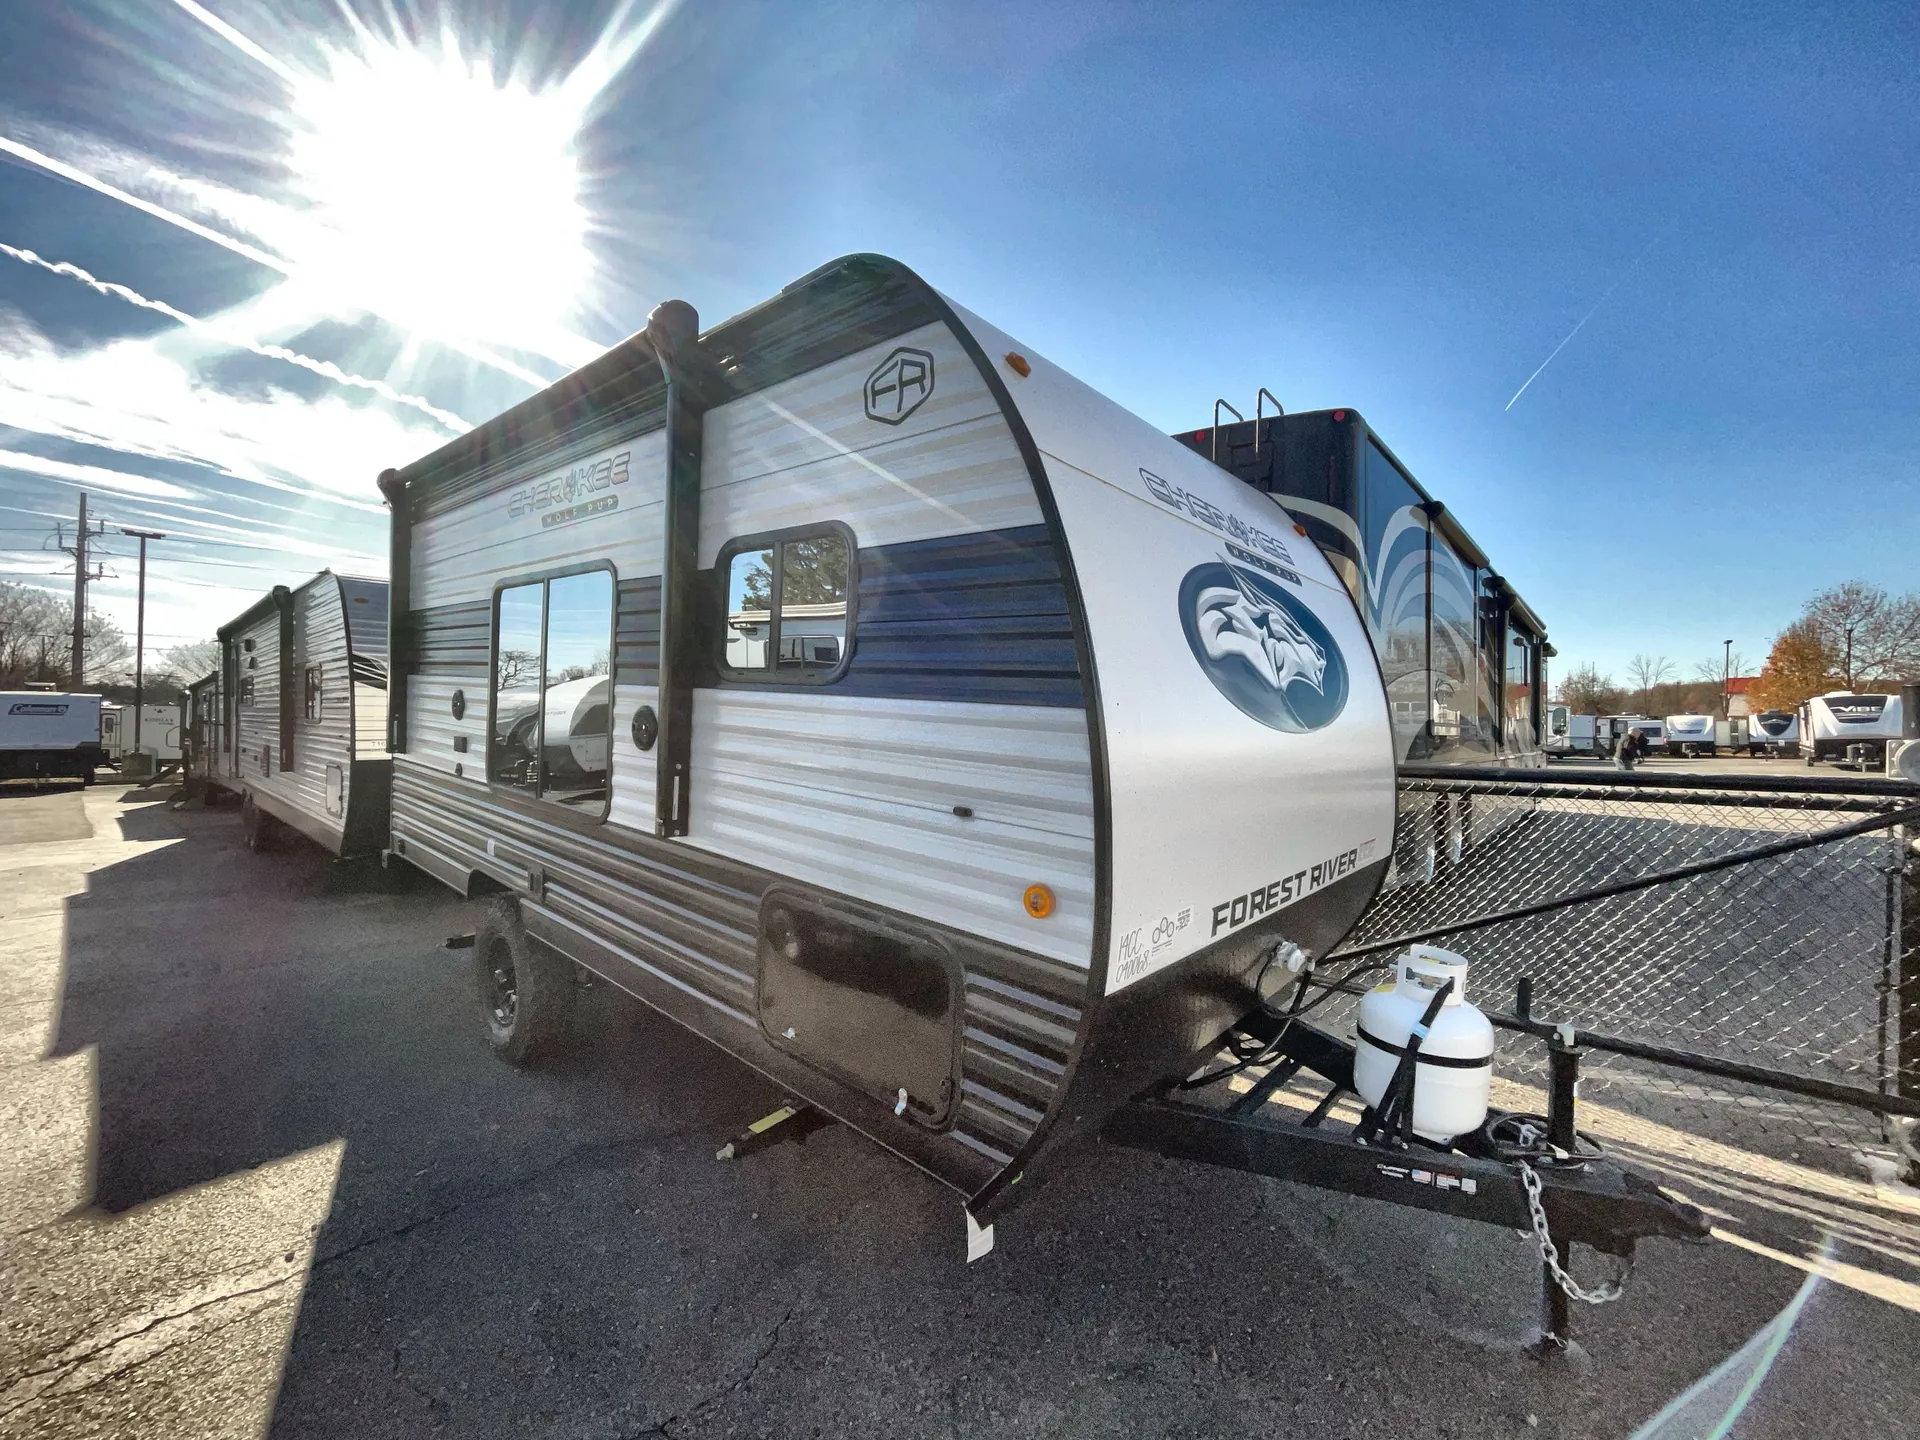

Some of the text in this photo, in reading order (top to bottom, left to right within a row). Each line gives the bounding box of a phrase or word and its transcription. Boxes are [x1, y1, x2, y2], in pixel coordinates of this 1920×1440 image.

[544, 498, 614, 524] WOLF PUP
[1231, 545, 1298, 582] WOLF PUP
[1211, 870, 1307, 938] FOREST
[1310, 848, 1358, 890] RIVER
